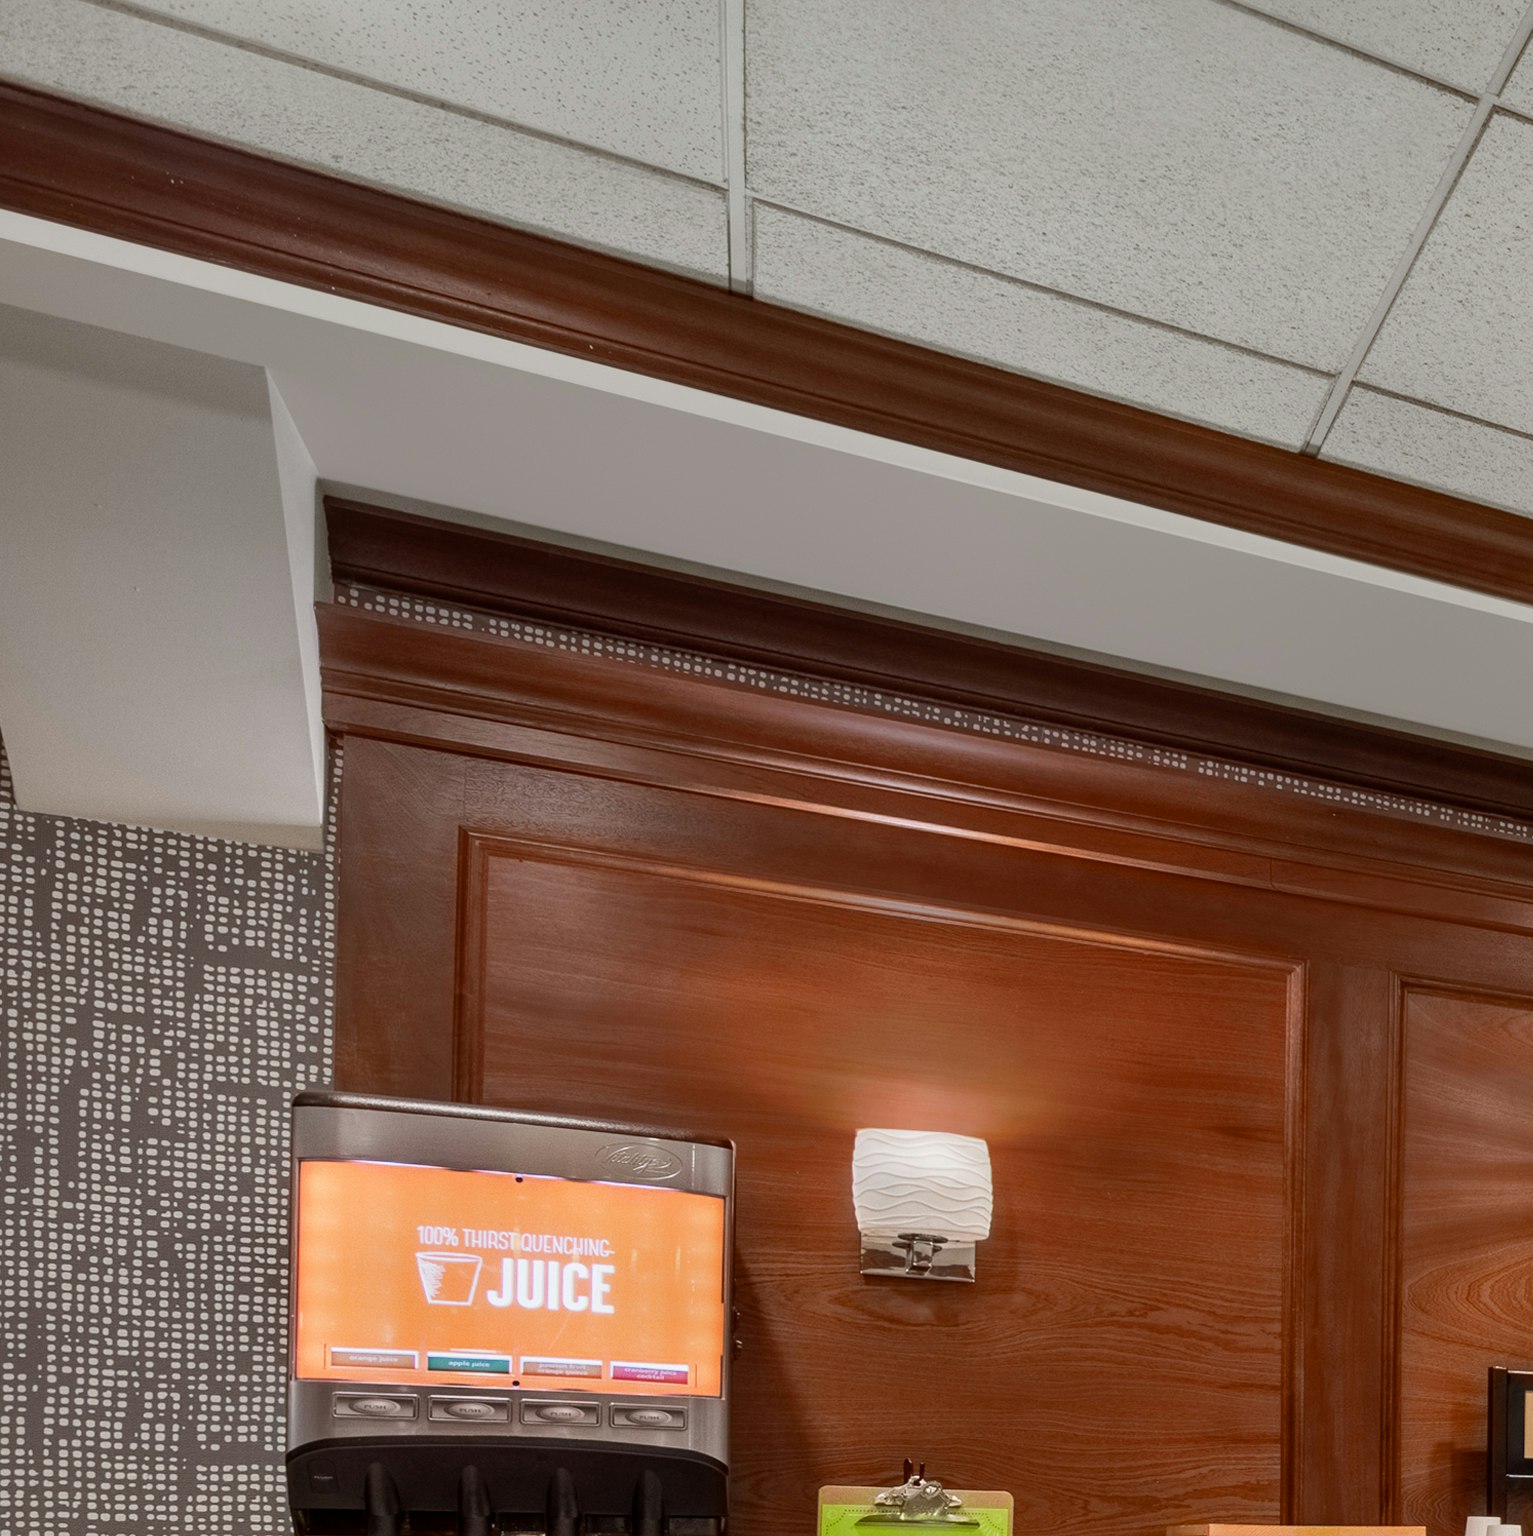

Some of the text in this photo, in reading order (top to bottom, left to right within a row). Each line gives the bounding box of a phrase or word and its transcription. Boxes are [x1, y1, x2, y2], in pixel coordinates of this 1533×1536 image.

[417, 1225, 610, 1257] 100% THIRST QUENCHING
[487, 1257, 615, 1314] JUICE
